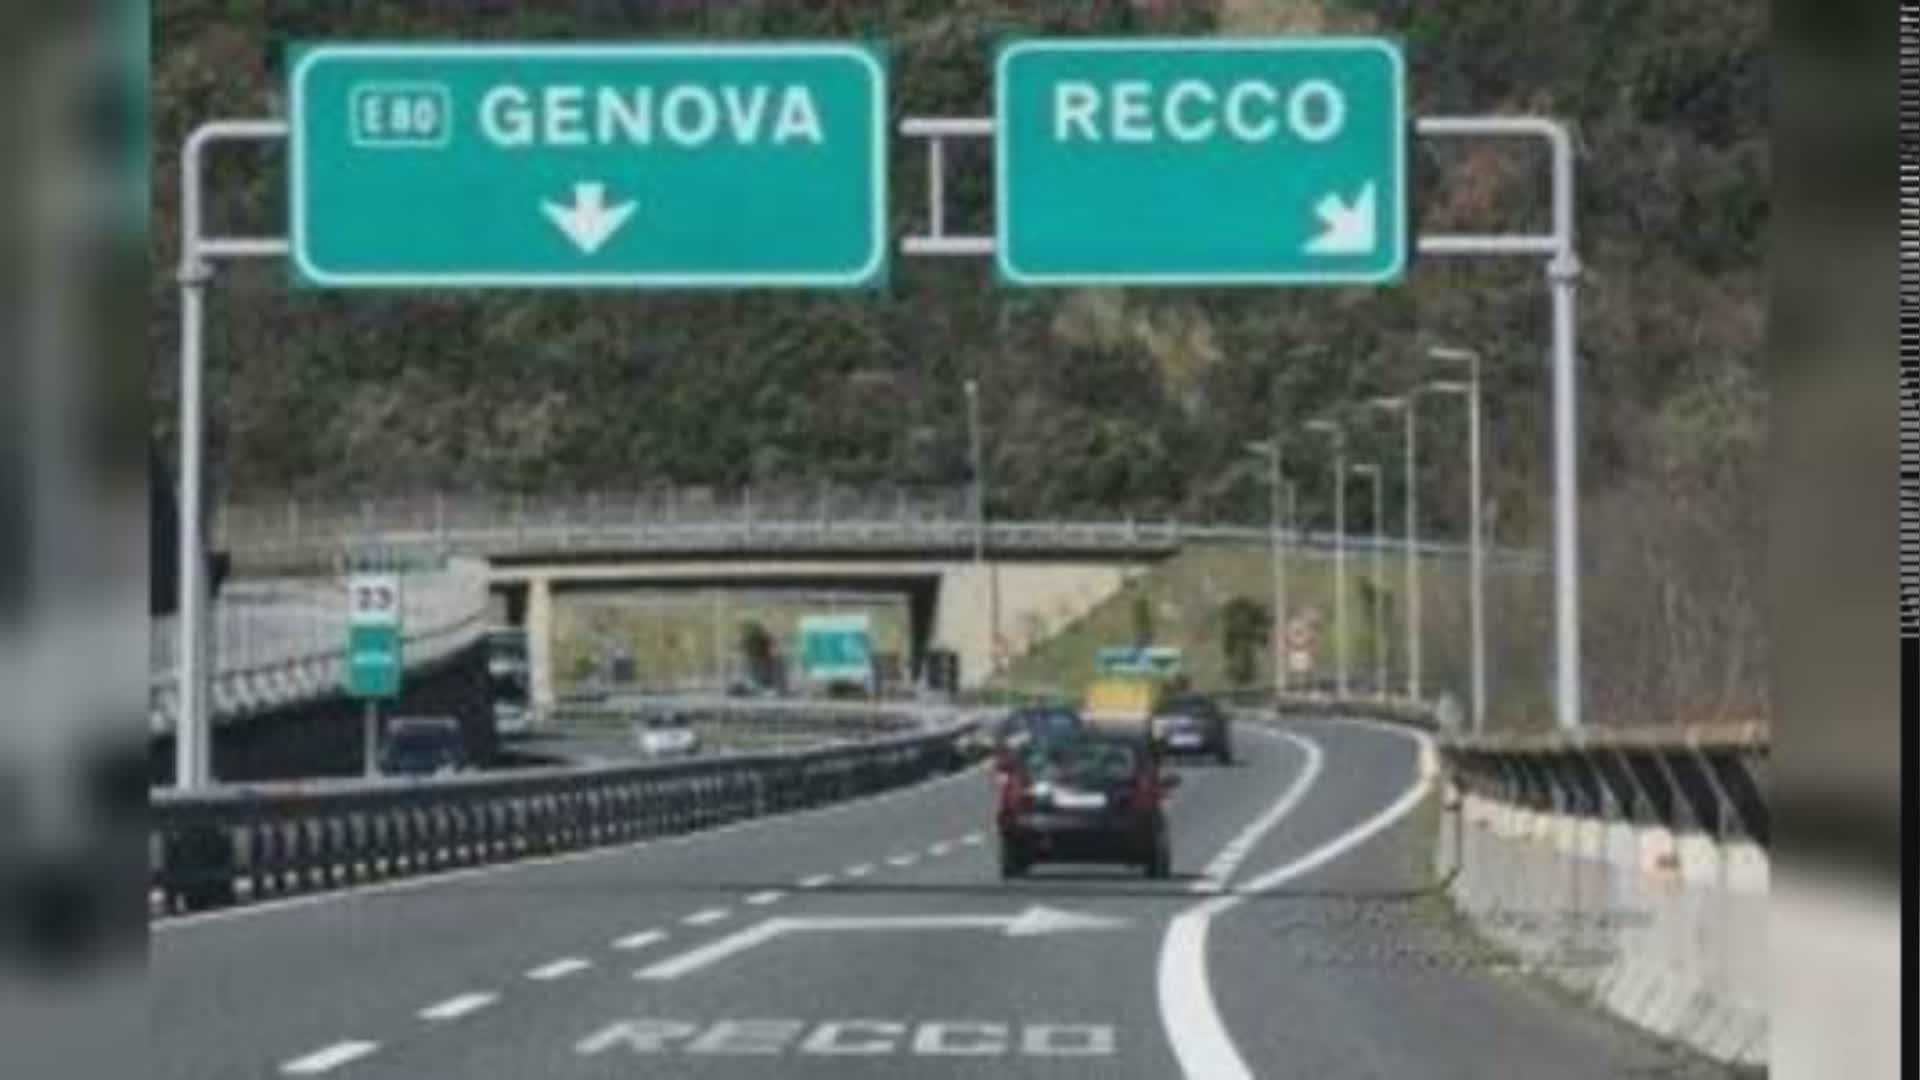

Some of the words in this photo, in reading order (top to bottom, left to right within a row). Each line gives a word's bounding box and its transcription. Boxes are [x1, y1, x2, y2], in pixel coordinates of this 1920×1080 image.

[364, 97, 384, 132] E
[479, 85, 823, 145] GENOVA
[1054, 79, 1346, 143] RECCO
[574, 1019, 1115, 1056] RECCO
